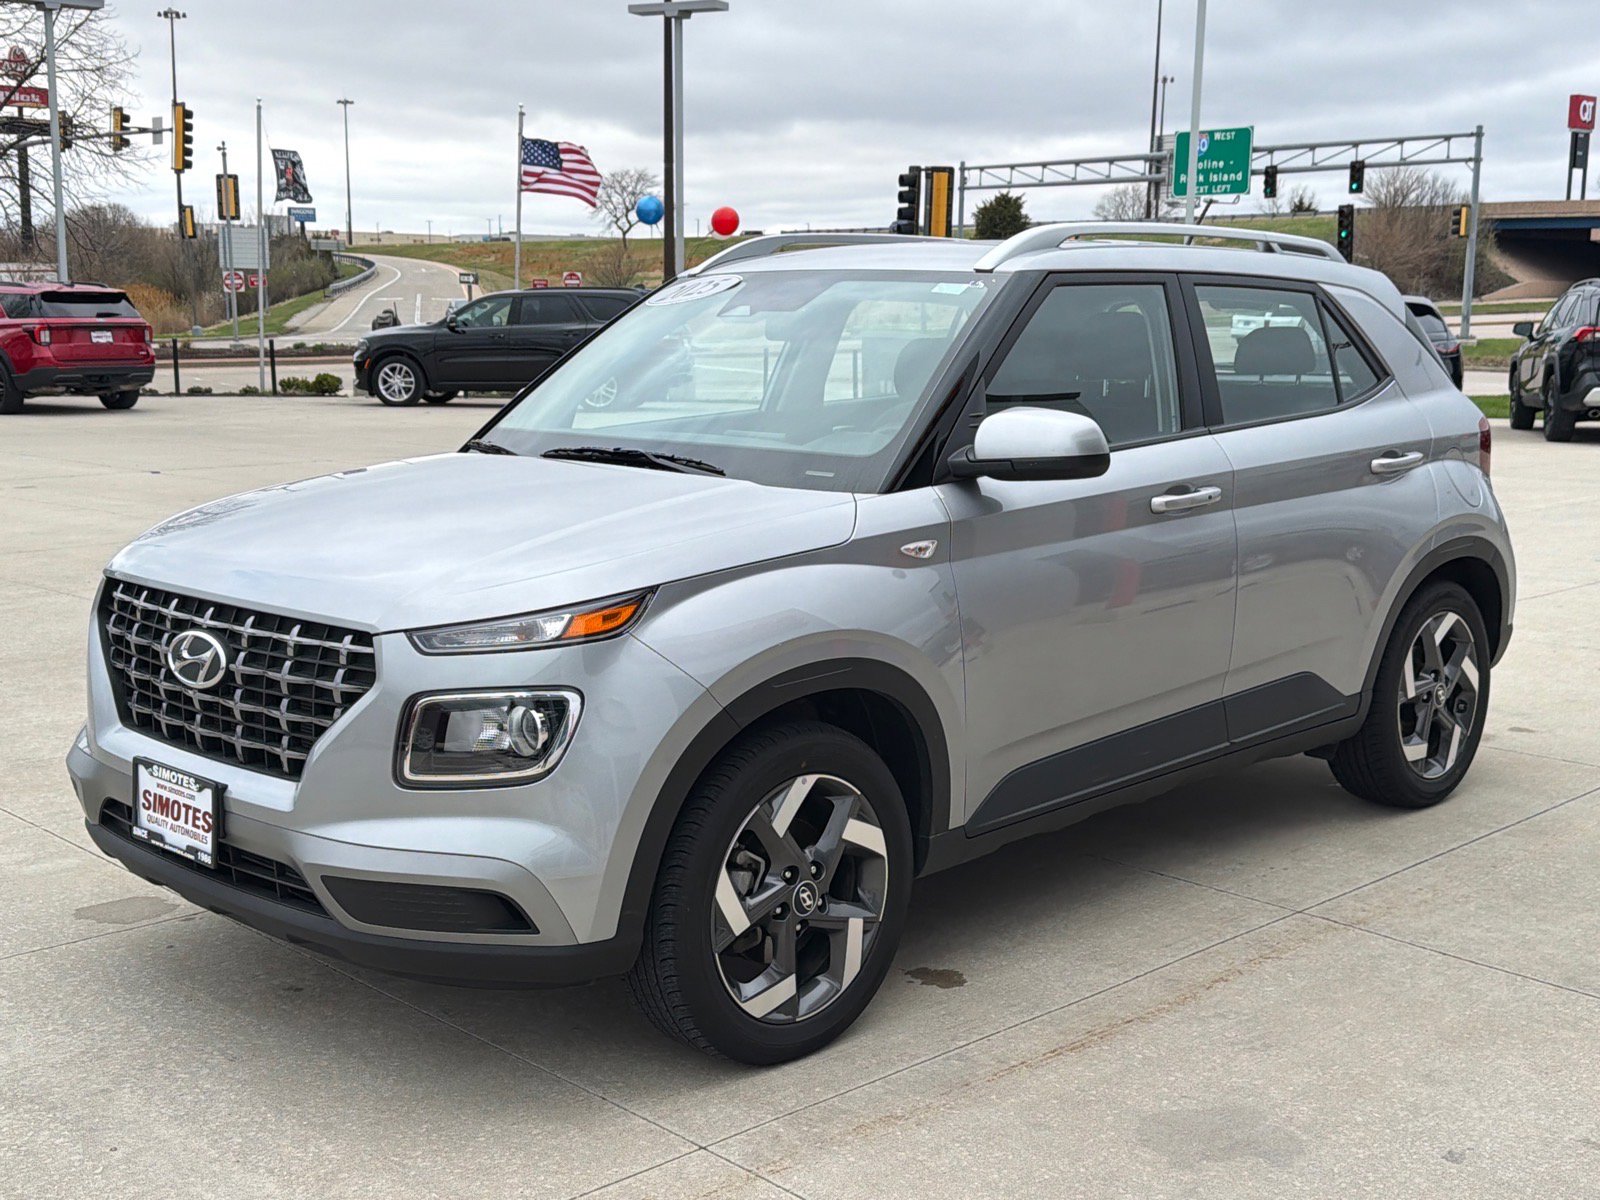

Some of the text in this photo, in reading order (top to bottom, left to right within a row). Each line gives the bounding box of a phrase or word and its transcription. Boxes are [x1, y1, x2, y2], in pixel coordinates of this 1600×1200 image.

[1213, 132, 1236, 141] WEST
[1197, 159, 1224, 170] oline
[1179, 171, 1243, 184] Rk Island
[152, 765, 196, 791] SIMOTES
[142, 789, 213, 834] SIMOTES
[146, 813, 208, 845] QUALITY AUTOMOBILES
